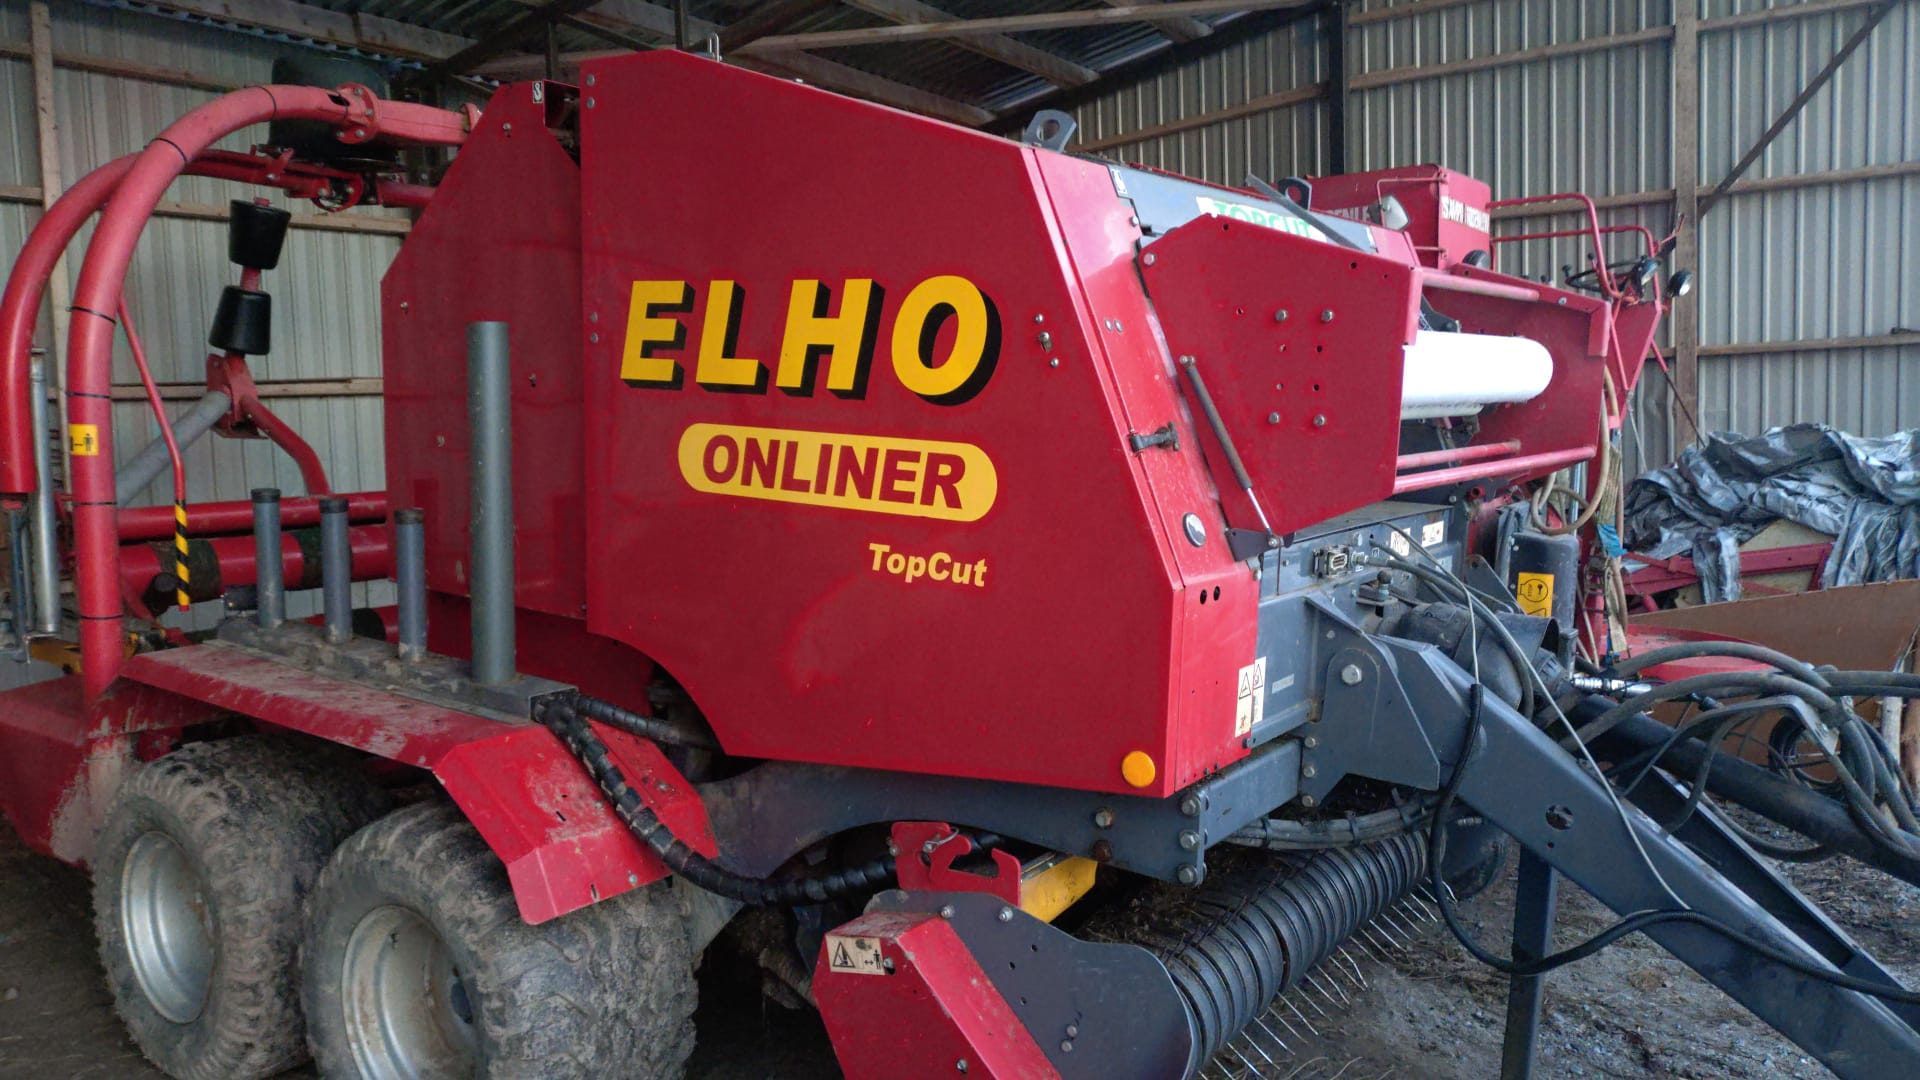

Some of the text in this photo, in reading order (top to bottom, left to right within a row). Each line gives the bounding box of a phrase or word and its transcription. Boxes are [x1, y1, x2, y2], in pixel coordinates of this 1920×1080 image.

[620, 275, 1000, 404] ELHO
[702, 434, 966, 510] ONLINER
[869, 543, 987, 587] TopCut
